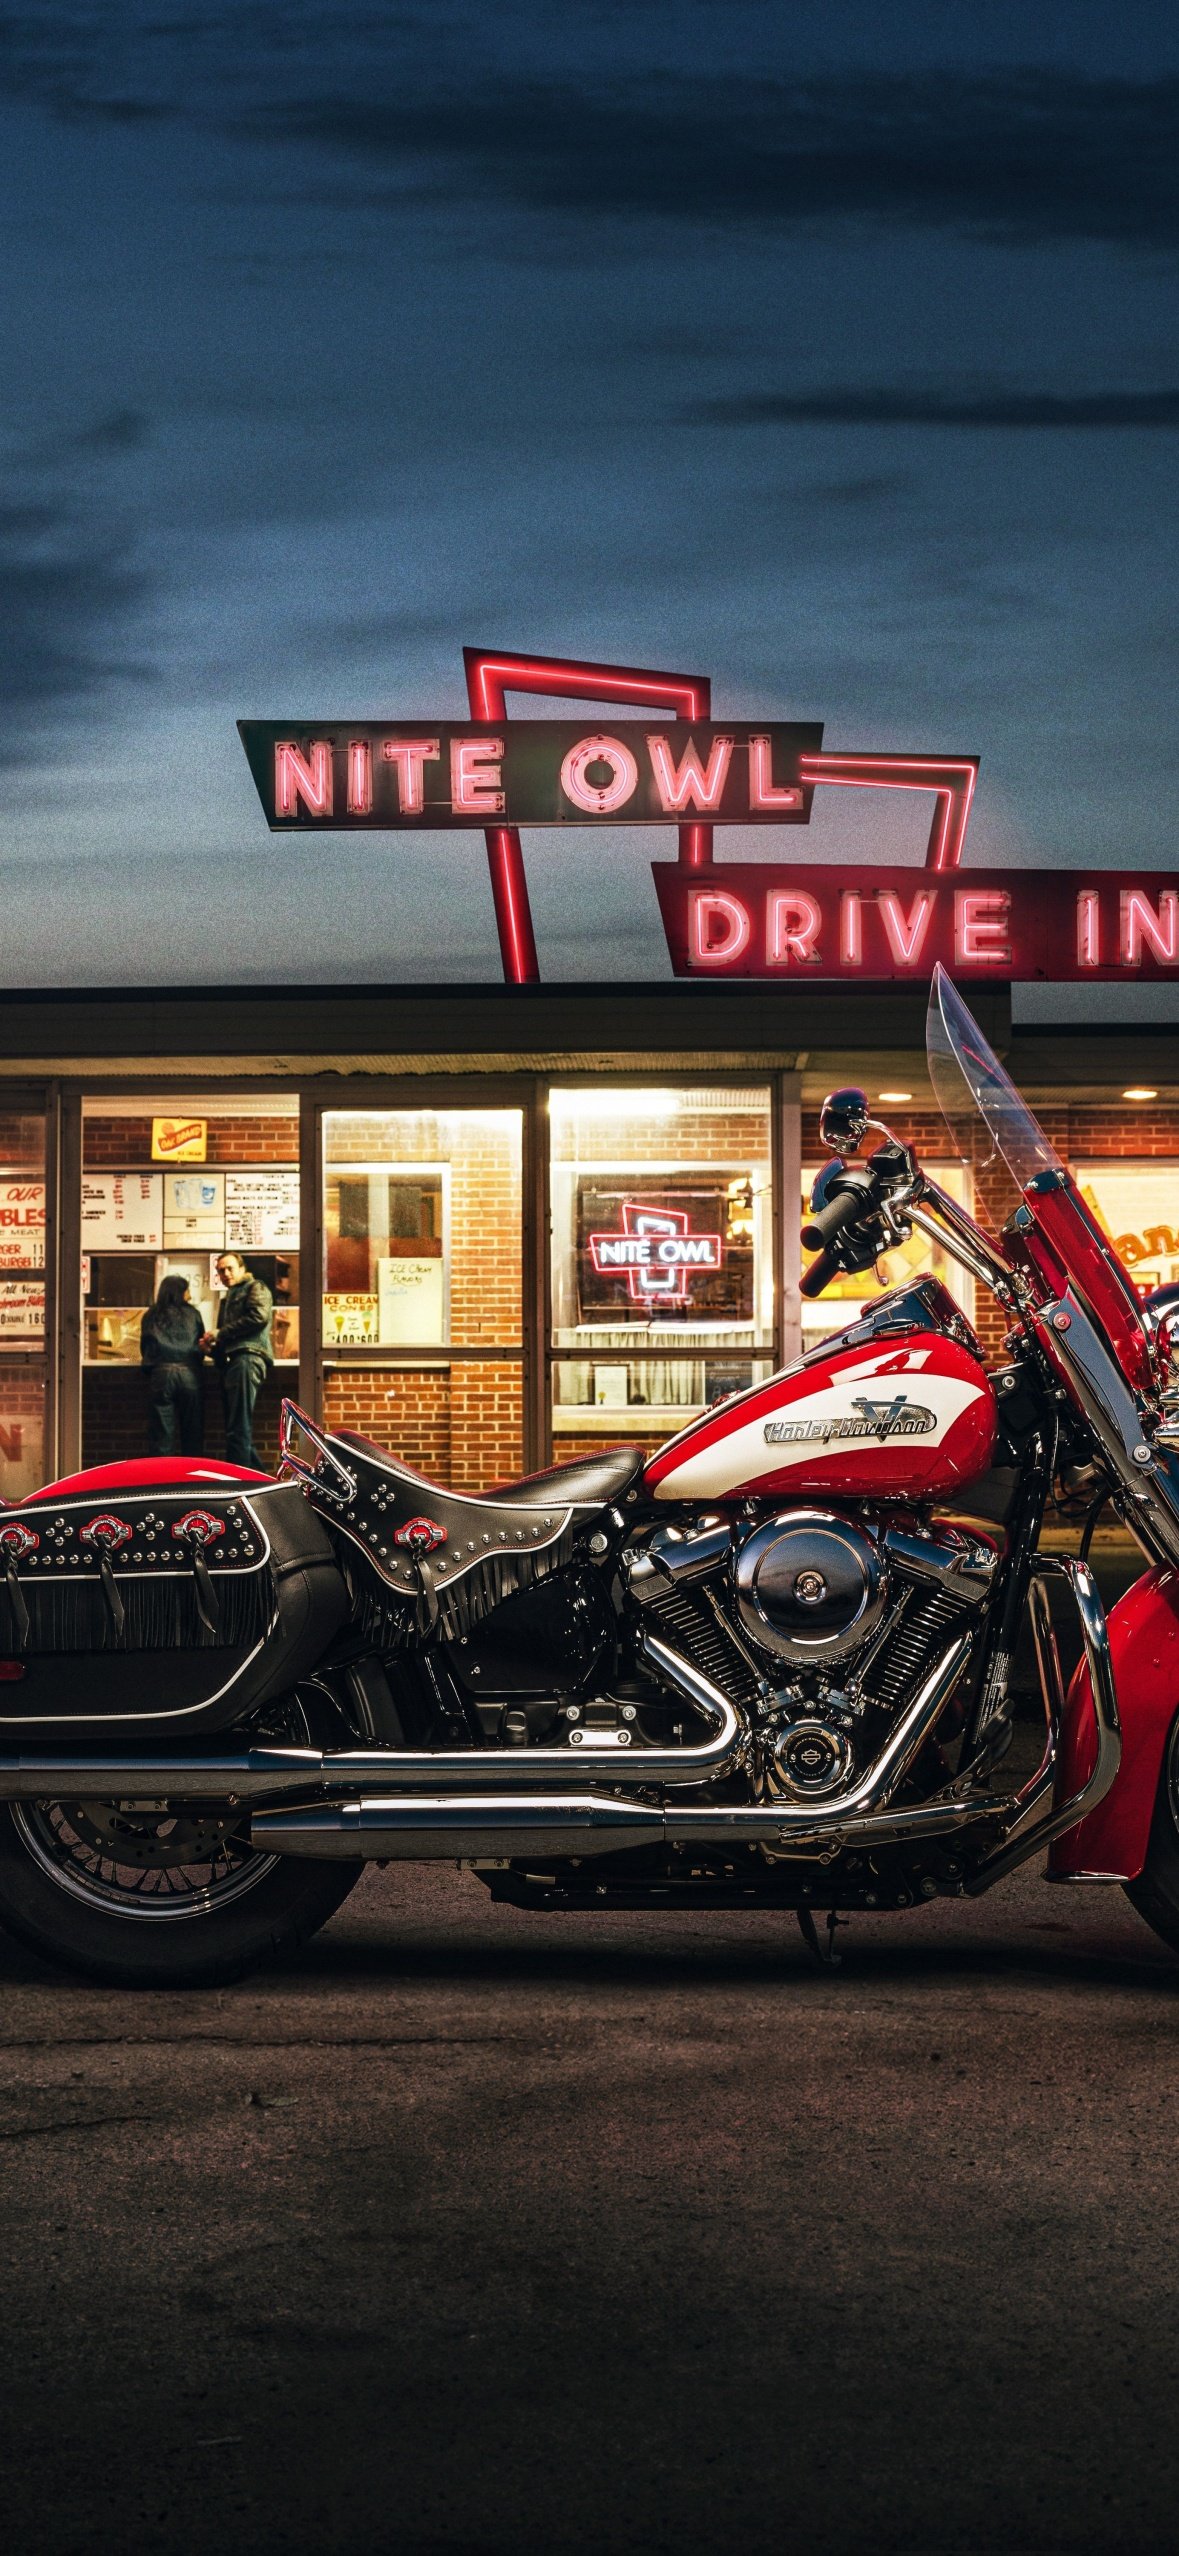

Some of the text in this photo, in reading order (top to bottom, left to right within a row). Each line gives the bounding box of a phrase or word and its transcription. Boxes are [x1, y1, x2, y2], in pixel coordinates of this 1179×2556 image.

[275, 735, 804, 817] NITE OWL
[687, 889, 1179, 967] DRIVE IN
[7, 1187, 44, 1202] OUR
[0, 1208, 46, 1227] BLES
[599, 1240, 716, 1263] NITE OWL
[324, 1296, 340, 1305] ICE
